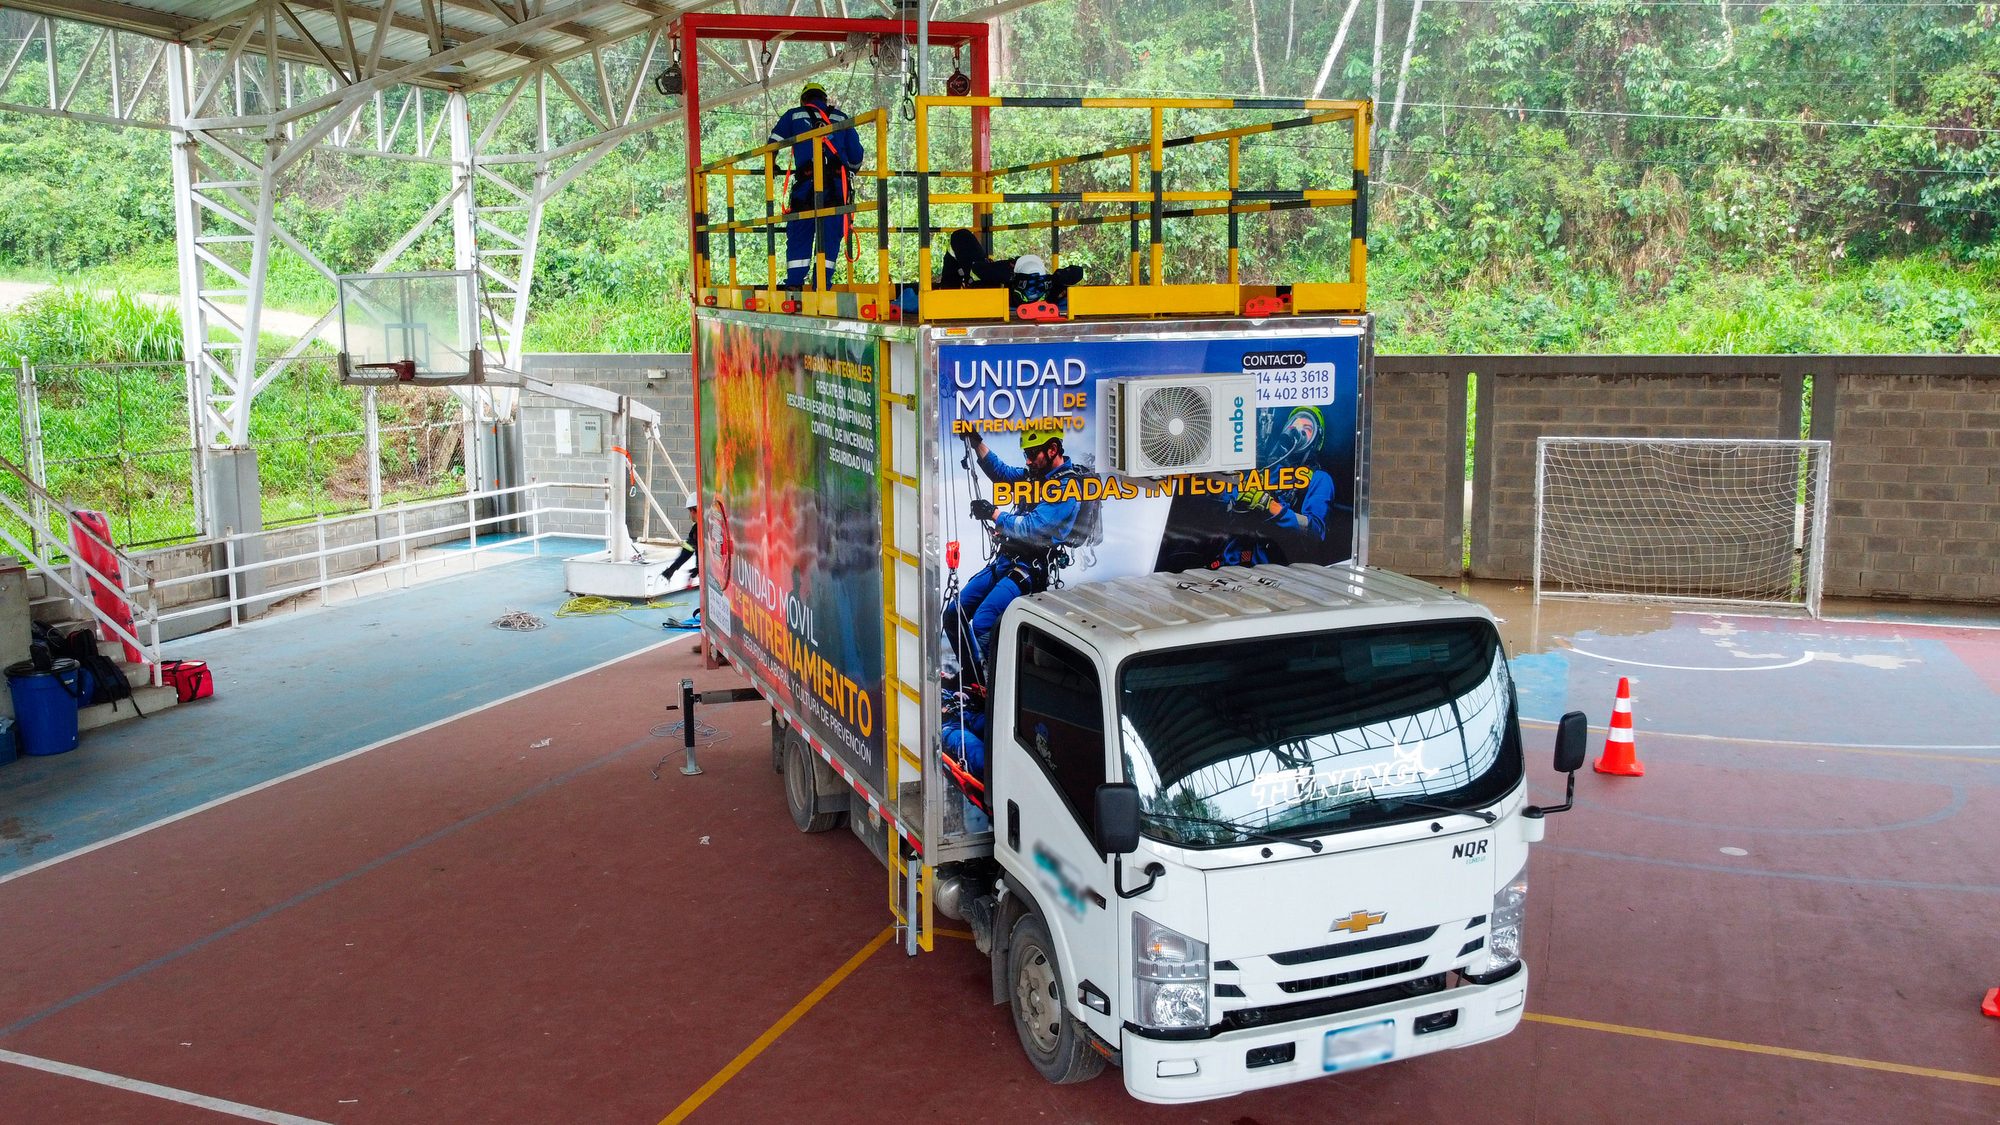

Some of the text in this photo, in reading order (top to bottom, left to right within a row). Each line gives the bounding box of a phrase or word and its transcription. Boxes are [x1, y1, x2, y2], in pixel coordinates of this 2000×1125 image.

[1243, 354, 1306, 366] CONTACTO:
[954, 358, 1087, 389] UNIDAD
[1251, 370, 1329, 384] 14 443 3618
[955, 388, 1087, 420] MOVIL DE
[1256, 386, 1329, 400] 14 402 8113
[834, 427, 843, 442] DE
[952, 416, 1085, 434] ENTRENAMIENTO
[1229, 396, 1244, 453] mabe
[860, 457, 874, 475] VIAL
[993, 477, 1138, 506] BRIGADAS
[737, 555, 777, 611] UNIDAD
[779, 586, 819, 648] MOVIL
[742, 598, 873, 738] ENTRENAMIENTO
[790, 680, 797, 693] Y
[819, 705, 830, 727] DE
[829, 714, 872, 767] PREVENCIÓN
[1452, 838, 1488, 859] NQR
